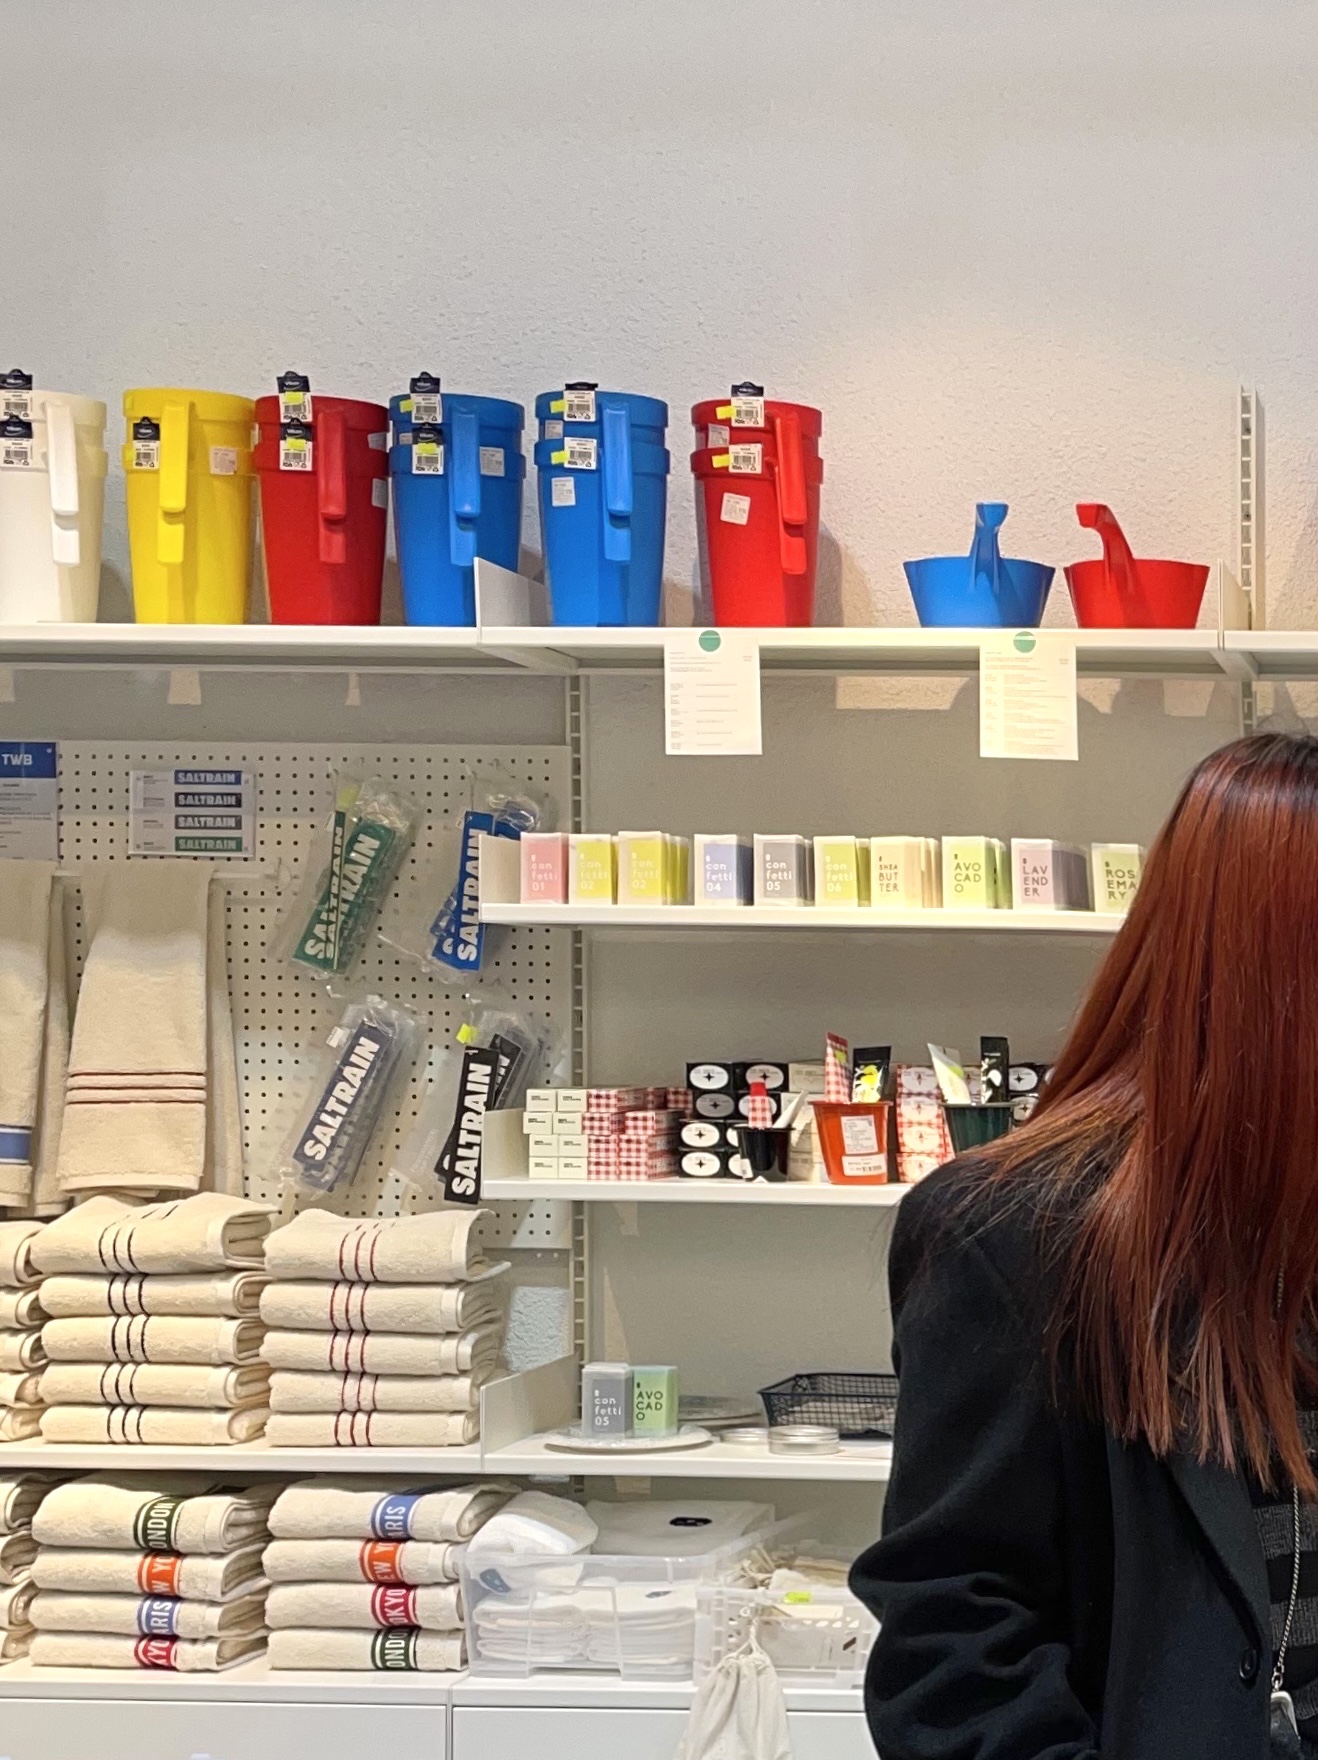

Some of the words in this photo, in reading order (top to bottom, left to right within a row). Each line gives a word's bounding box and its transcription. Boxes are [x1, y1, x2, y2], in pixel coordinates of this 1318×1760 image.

[1, 753, 33, 766] TWB
[177, 772, 235, 784] SALTRAIN
[178, 794, 236, 806] SALTRAIN
[178, 817, 236, 828] SALTRAIN
[178, 839, 237, 850] SALTRAIN
[954, 862, 982, 872] AVO
[1023, 866, 1048, 875] LAV
[878, 872, 898, 882] BUT
[954, 873, 982, 882] CAD
[1106, 869, 1136, 879] ROS
[1024, 876, 1048, 886] END
[1107, 880, 1137, 890] EMA
[879, 883, 900, 892] TER
[954, 883, 964, 893] O
[1024, 887, 1040, 896] ER
[304, 833, 380, 960] SARAIN
[1108, 890, 1126, 900] RY
[304, 1036, 380, 1160] SALTRAIN
[452, 1062, 492, 1196] SALTRAIN
[636, 1390, 664, 1400] AVO
[594, 1406, 622, 1415] fetti
[636, 1401, 663, 1411] CAD
[636, 1412, 646, 1421] O
[148, 1502, 176, 1548] ONDON
[384, 1506, 406, 1538] ARIS
[384, 1588, 409, 1624] OKYO
[150, 1601, 172, 1634] ARIS
[384, 1628, 409, 1668] ONDO
